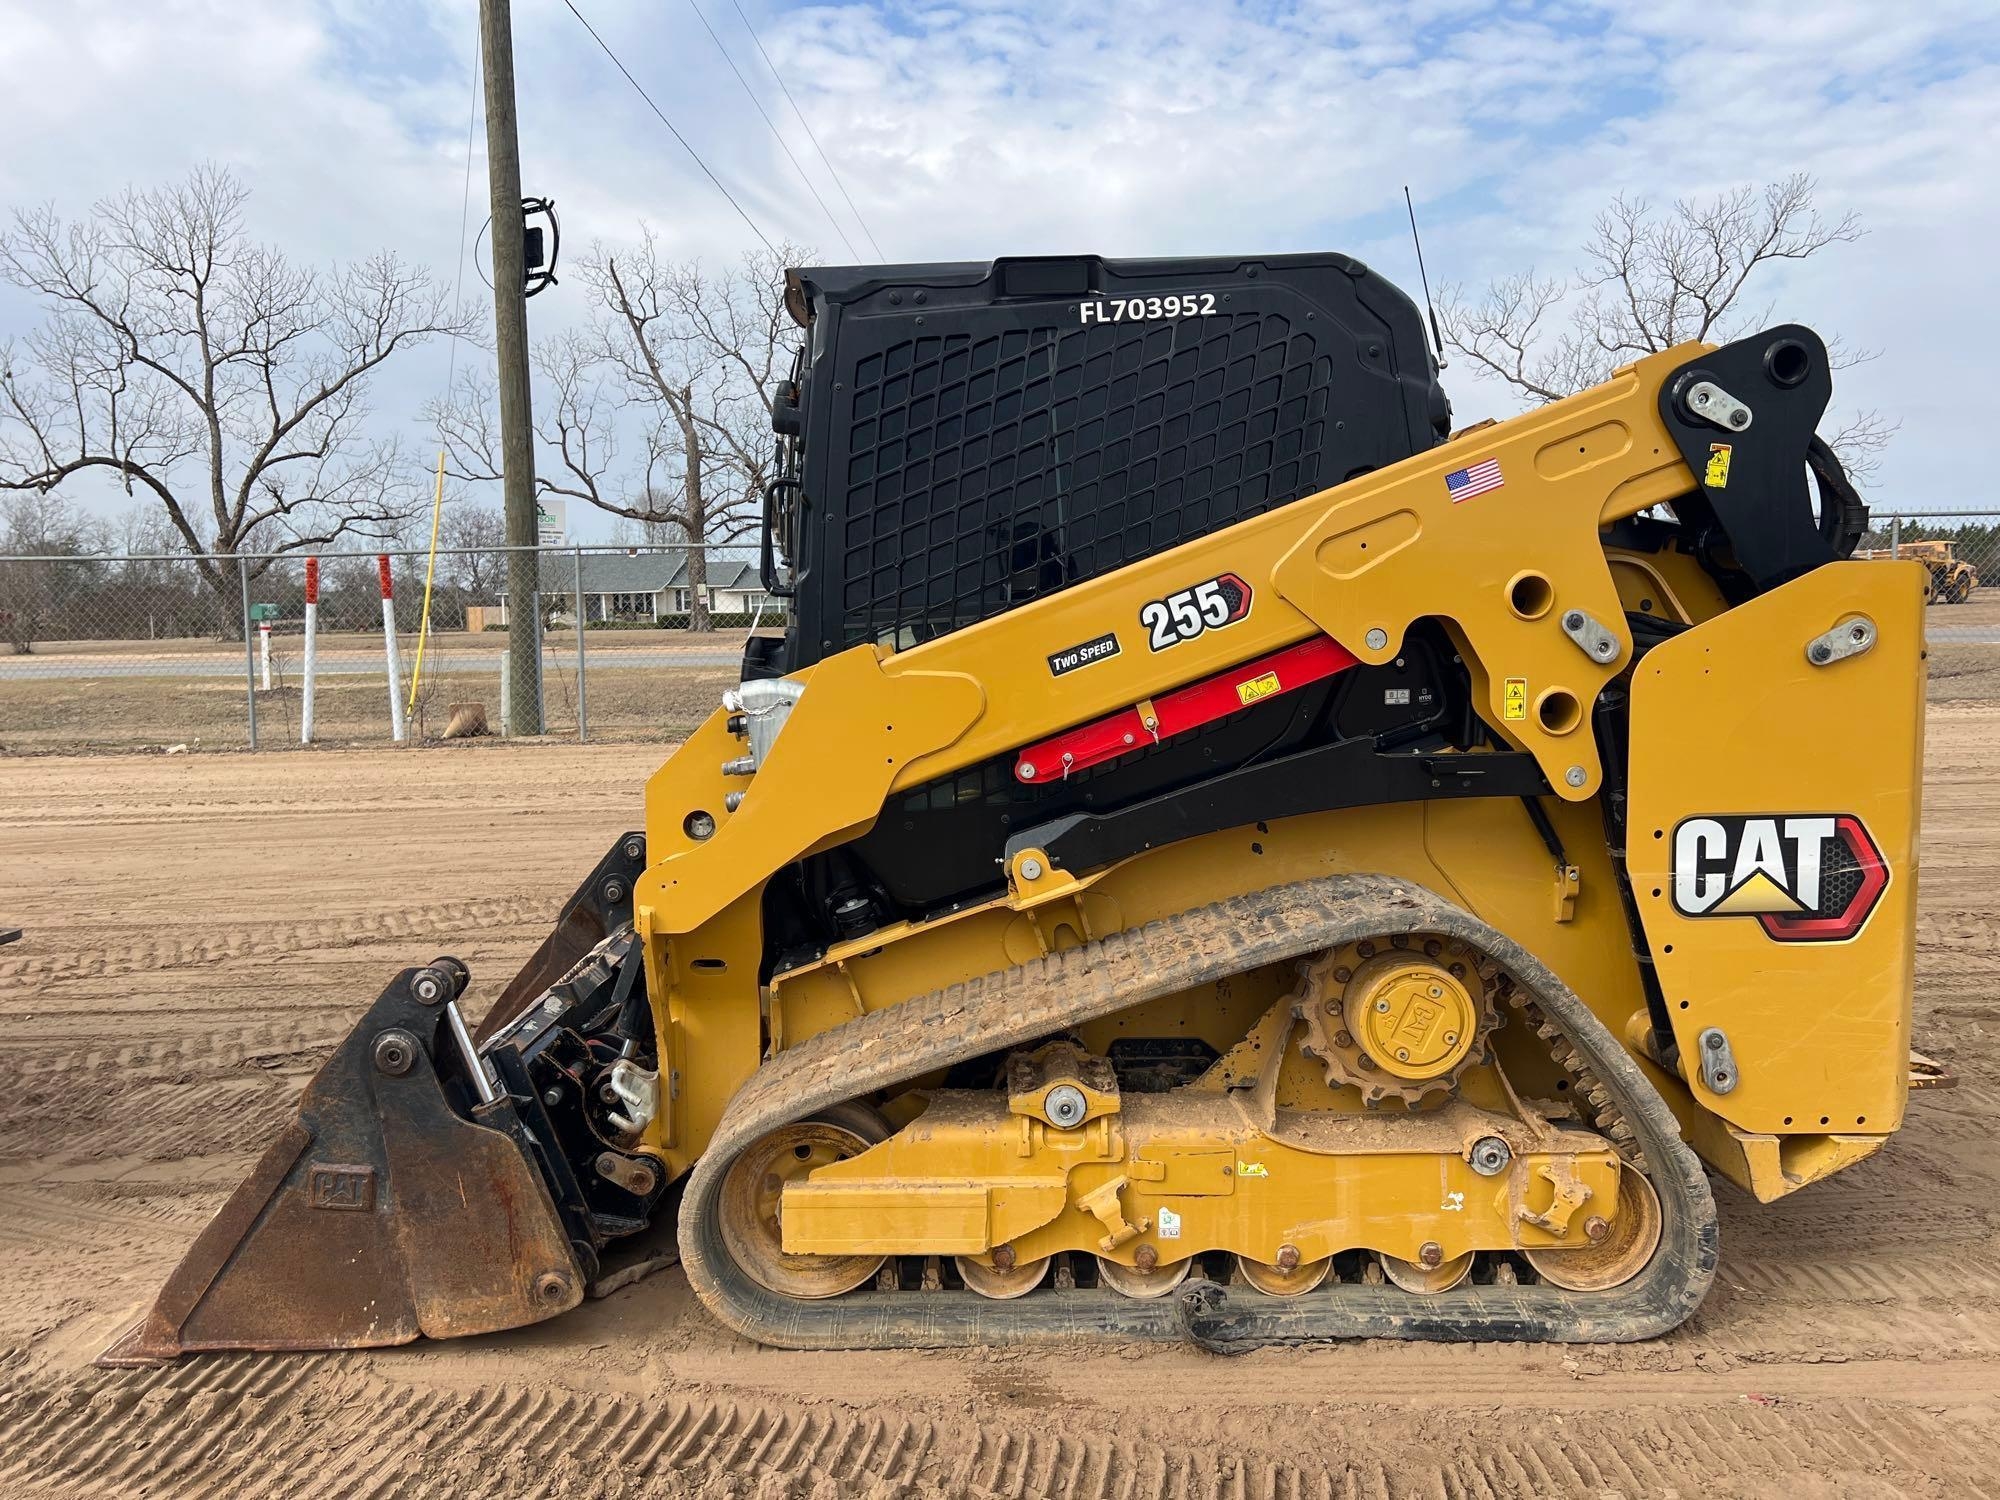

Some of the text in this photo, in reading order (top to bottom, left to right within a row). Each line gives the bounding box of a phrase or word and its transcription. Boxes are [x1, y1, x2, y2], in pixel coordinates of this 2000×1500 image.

[1079, 293, 1217, 324] FL703952
[538, 515, 556, 523] SON
[1142, 580, 1229, 649] 255
[1676, 817, 1836, 913] CAT
[315, 1173, 368, 1207] CAT
